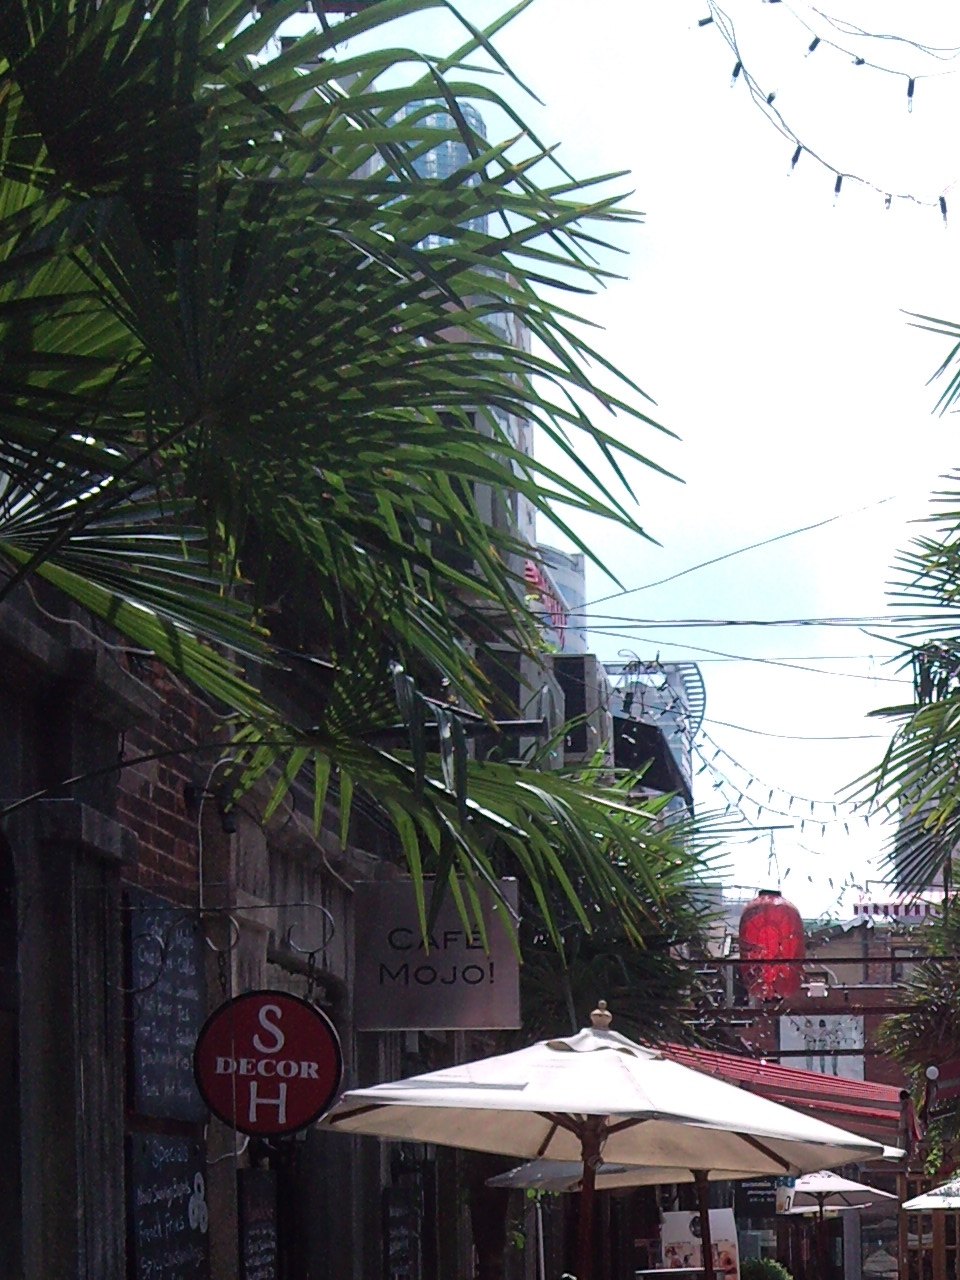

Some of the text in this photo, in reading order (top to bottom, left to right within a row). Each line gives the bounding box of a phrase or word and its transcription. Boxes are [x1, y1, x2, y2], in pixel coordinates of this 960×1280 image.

[379, 962, 494, 985] MOJO!
[252, 1004, 285, 1054] S
[215, 1056, 320, 1079] DECOR
[248, 1080, 288, 1124] H
